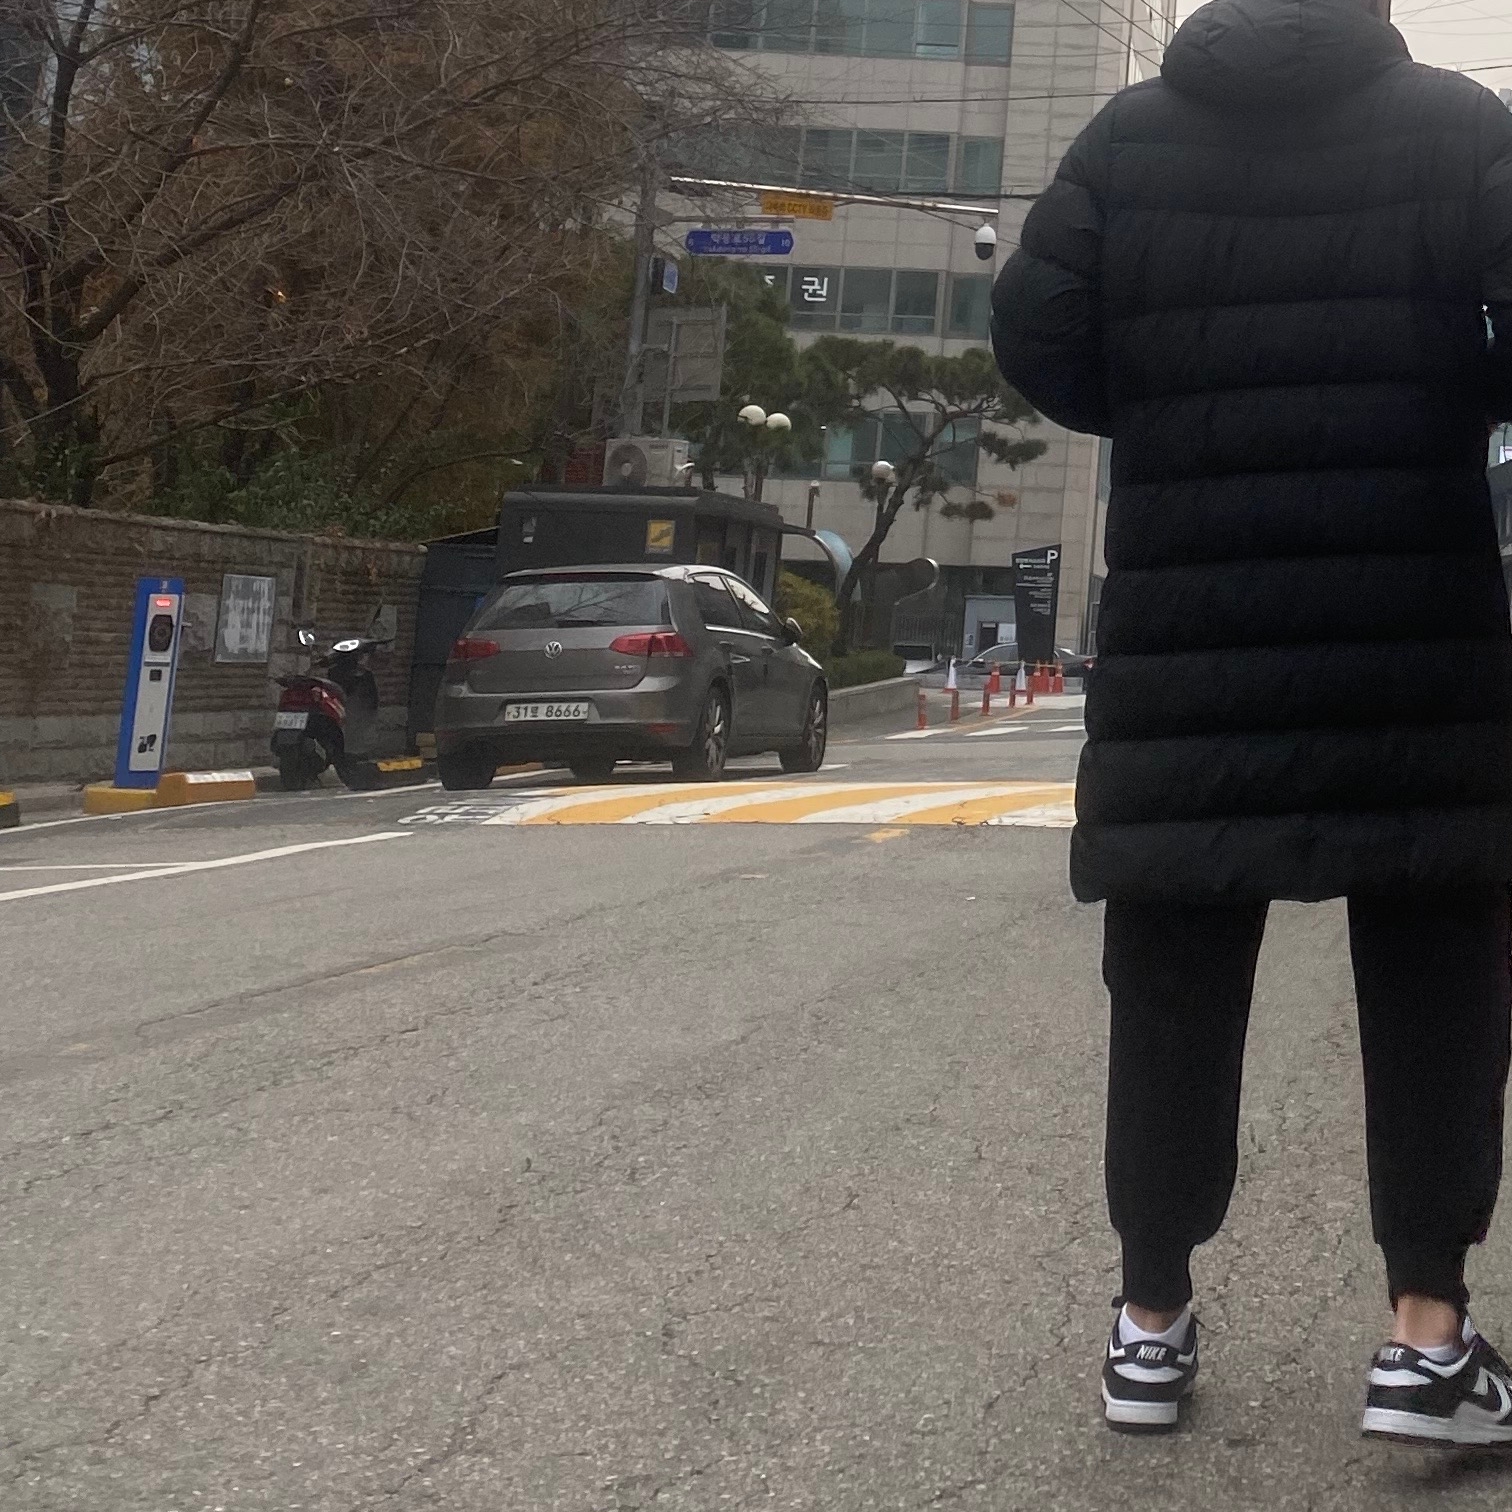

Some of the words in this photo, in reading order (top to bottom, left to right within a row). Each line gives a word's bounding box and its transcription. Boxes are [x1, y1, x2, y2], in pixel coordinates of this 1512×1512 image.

[1047, 549, 1059, 565] P
[545, 704, 581, 718] 8666
[1136, 1344, 1167, 1361] NIKE
